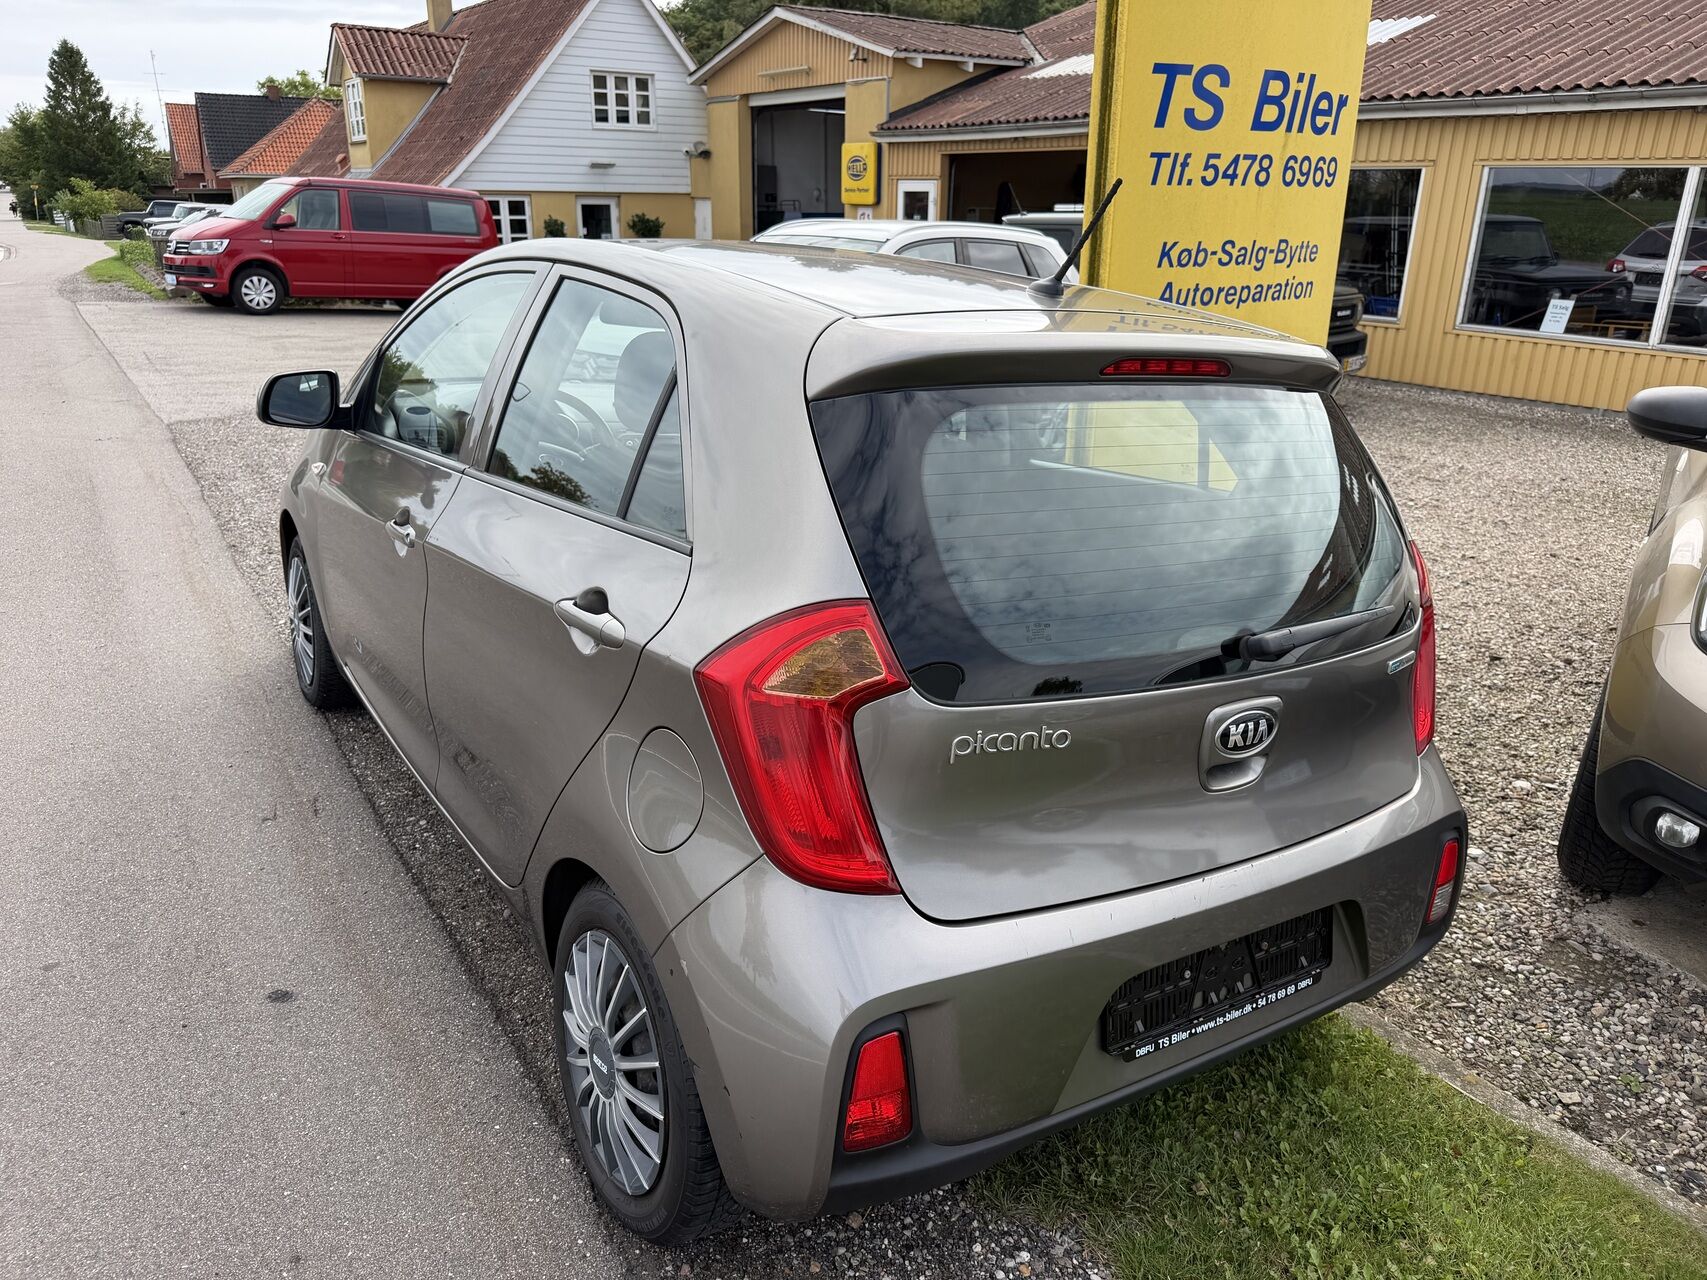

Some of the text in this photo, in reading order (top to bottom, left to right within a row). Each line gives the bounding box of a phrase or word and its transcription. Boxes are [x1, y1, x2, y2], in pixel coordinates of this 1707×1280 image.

[1152, 62, 1349, 135] TS Biler
[1149, 152, 1338, 188] Tlf. 5478 6969
[1156, 238, 1319, 272] Køb-Salg-Bytte
[1159, 275, 1314, 309] Autoreparation
[950, 725, 1072, 764] picanto
[1228, 719, 1268, 748] KIA
[1135, 1043, 1155, 1058] DBFU
[1158, 1037, 1170, 1049] TS
[1171, 1030, 1191, 1044] Biler
[1195, 1003, 1253, 1034] www.ts-biler.dk
[1257, 998, 1266, 1008] 54
[1268, 995, 1277, 1004] 78
[1277, 989, 1286, 999] 69
[1287, 984, 1295, 995] 69
